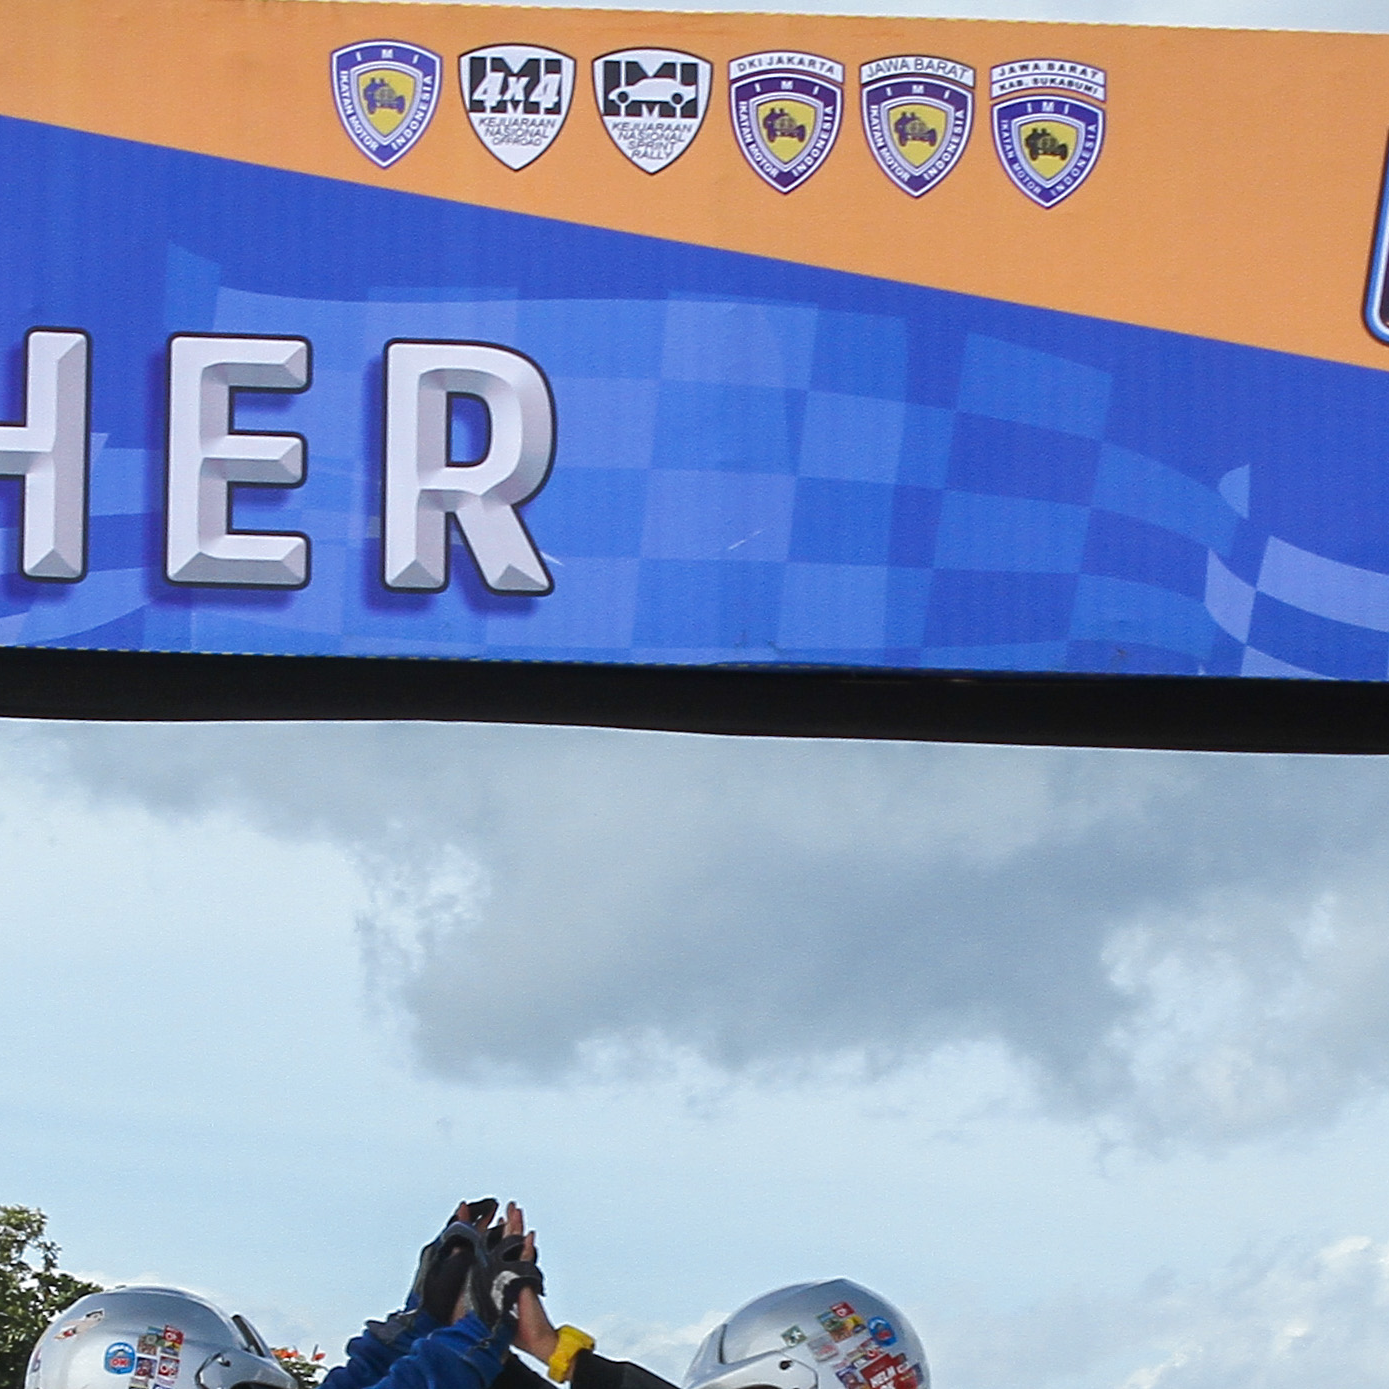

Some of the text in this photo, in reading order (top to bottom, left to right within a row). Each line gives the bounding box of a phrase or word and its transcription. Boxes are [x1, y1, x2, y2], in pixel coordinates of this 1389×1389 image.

[736, 56, 835, 76] DKI JAKARTA
[864, 56, 970, 80] JAWA BARAT
[997, 60, 1099, 80] JAWA BARAT
[1031, 75, 1099, 95] SUKABUMI
[392, 74, 433, 150] INDONESIA
[478, 117, 556, 129] KEJUARAAN
[350, 116, 380, 151] MOTOR
[485, 128, 549, 140] NASIONAL
[611, 121, 693, 133] KEJUARAAN
[617, 131, 686, 143] NASIONAL
[492, 137, 543, 147] OFFROAD
[627, 141, 678, 152] SPRINT
[738, 100, 780, 179] IKATAN MOTOR
[791, 105, 834, 178] INDONESIA
[870, 104, 911, 184] IKATAN MOTOR
[922, 109, 966, 182] INDONESIA
[631, 150, 674, 161] RALLY
[1049, 122, 1098, 198] INDONESIA
[1011, 160, 1042, 195] MOTOR
[869, 1365, 897, 1389] HELM
